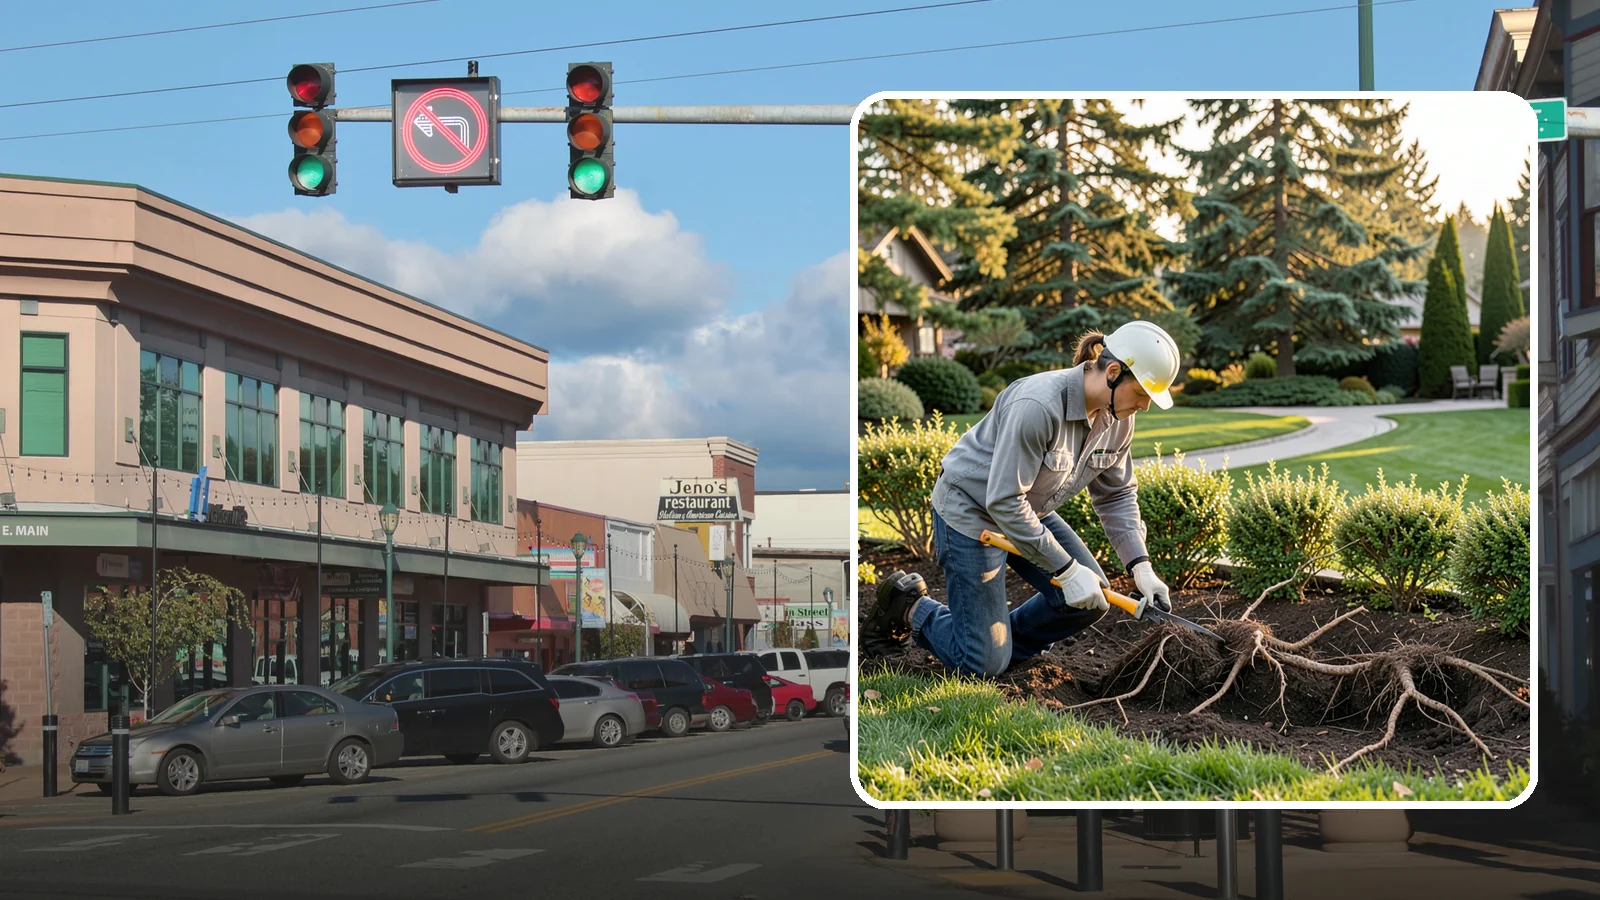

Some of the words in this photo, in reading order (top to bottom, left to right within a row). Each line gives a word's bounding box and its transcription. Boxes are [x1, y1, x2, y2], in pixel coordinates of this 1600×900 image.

[670, 480, 727, 494] Jeno's
[665, 497, 731, 509] restaurant
[658, 510, 681, 519] Italian
[686, 510, 714, 519] American
[715, 510, 737, 519] Cuisine
[2, 525, 13, 536] E.
[15, 525, 49, 536] MAIN
[797, 607, 828, 617] Street
